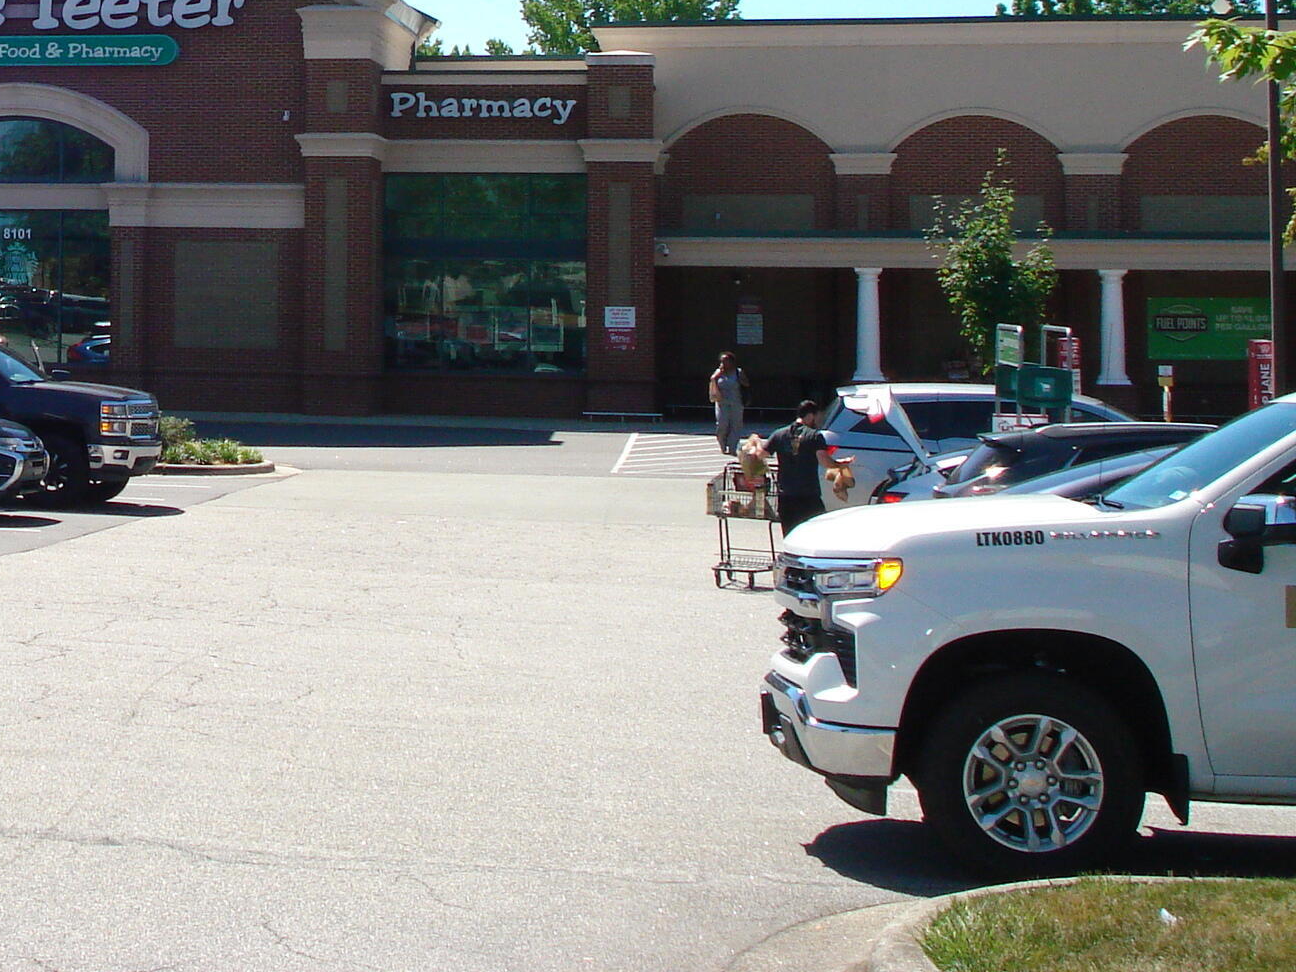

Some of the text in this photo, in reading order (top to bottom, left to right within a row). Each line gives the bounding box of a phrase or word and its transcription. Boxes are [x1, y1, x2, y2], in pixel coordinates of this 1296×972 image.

[44, 41, 64, 59] &
[67, 42, 164, 62] Pharmacy
[390, 91, 577, 125] Pharmacy
[3, 227, 32, 240] 8101
[1155, 316, 1207, 330] FUEL POINTS
[1260, 363, 1272, 394] LANE
[975, 530, 1045, 547] LTK0880
